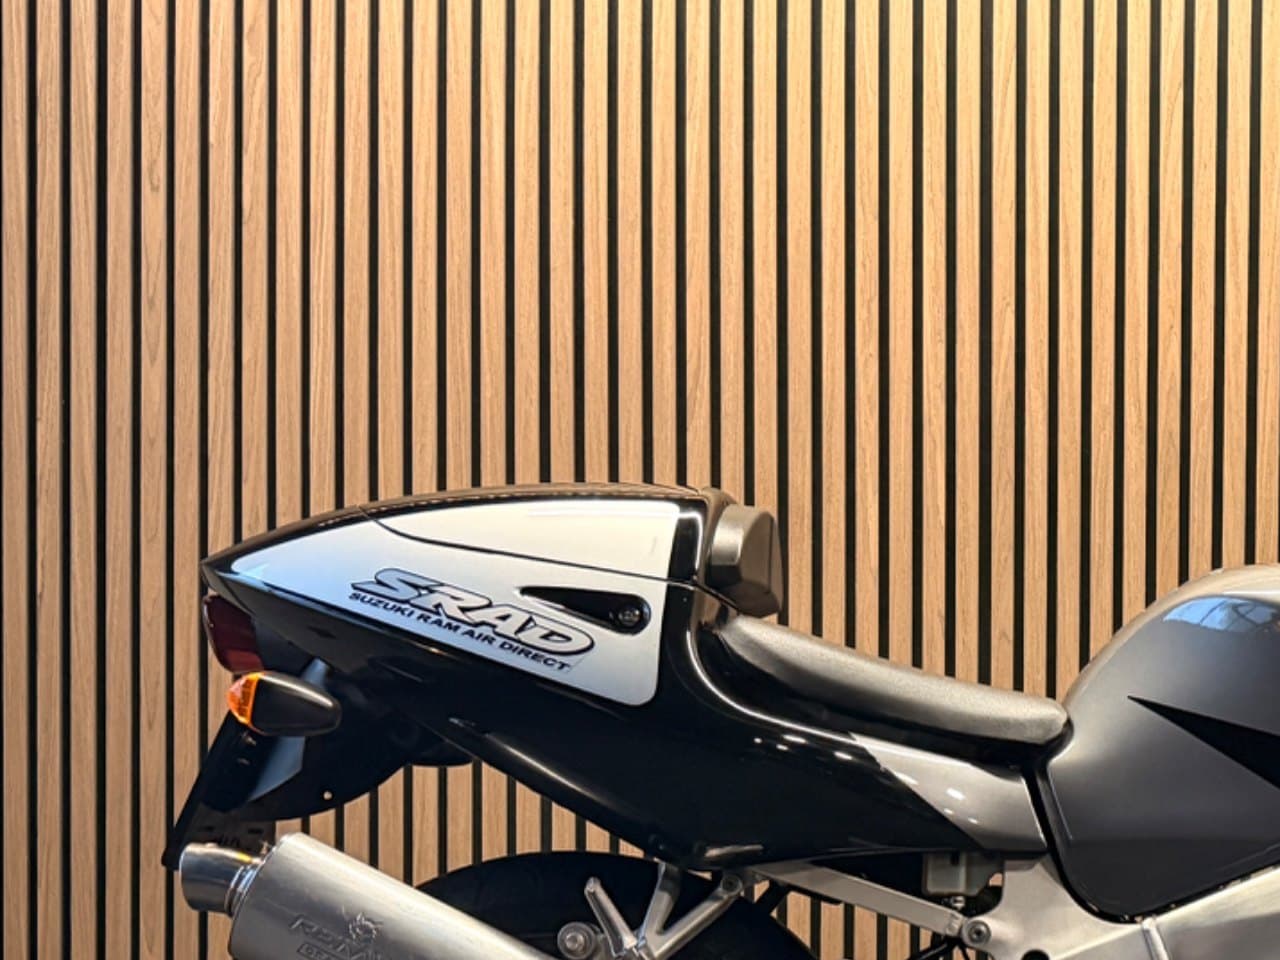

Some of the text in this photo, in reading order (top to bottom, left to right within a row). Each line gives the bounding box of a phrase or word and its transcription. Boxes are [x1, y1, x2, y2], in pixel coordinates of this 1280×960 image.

[349, 592, 571, 672] SUZUKI RAM AIR DIRECT
[351, 568, 595, 656] SRAD
